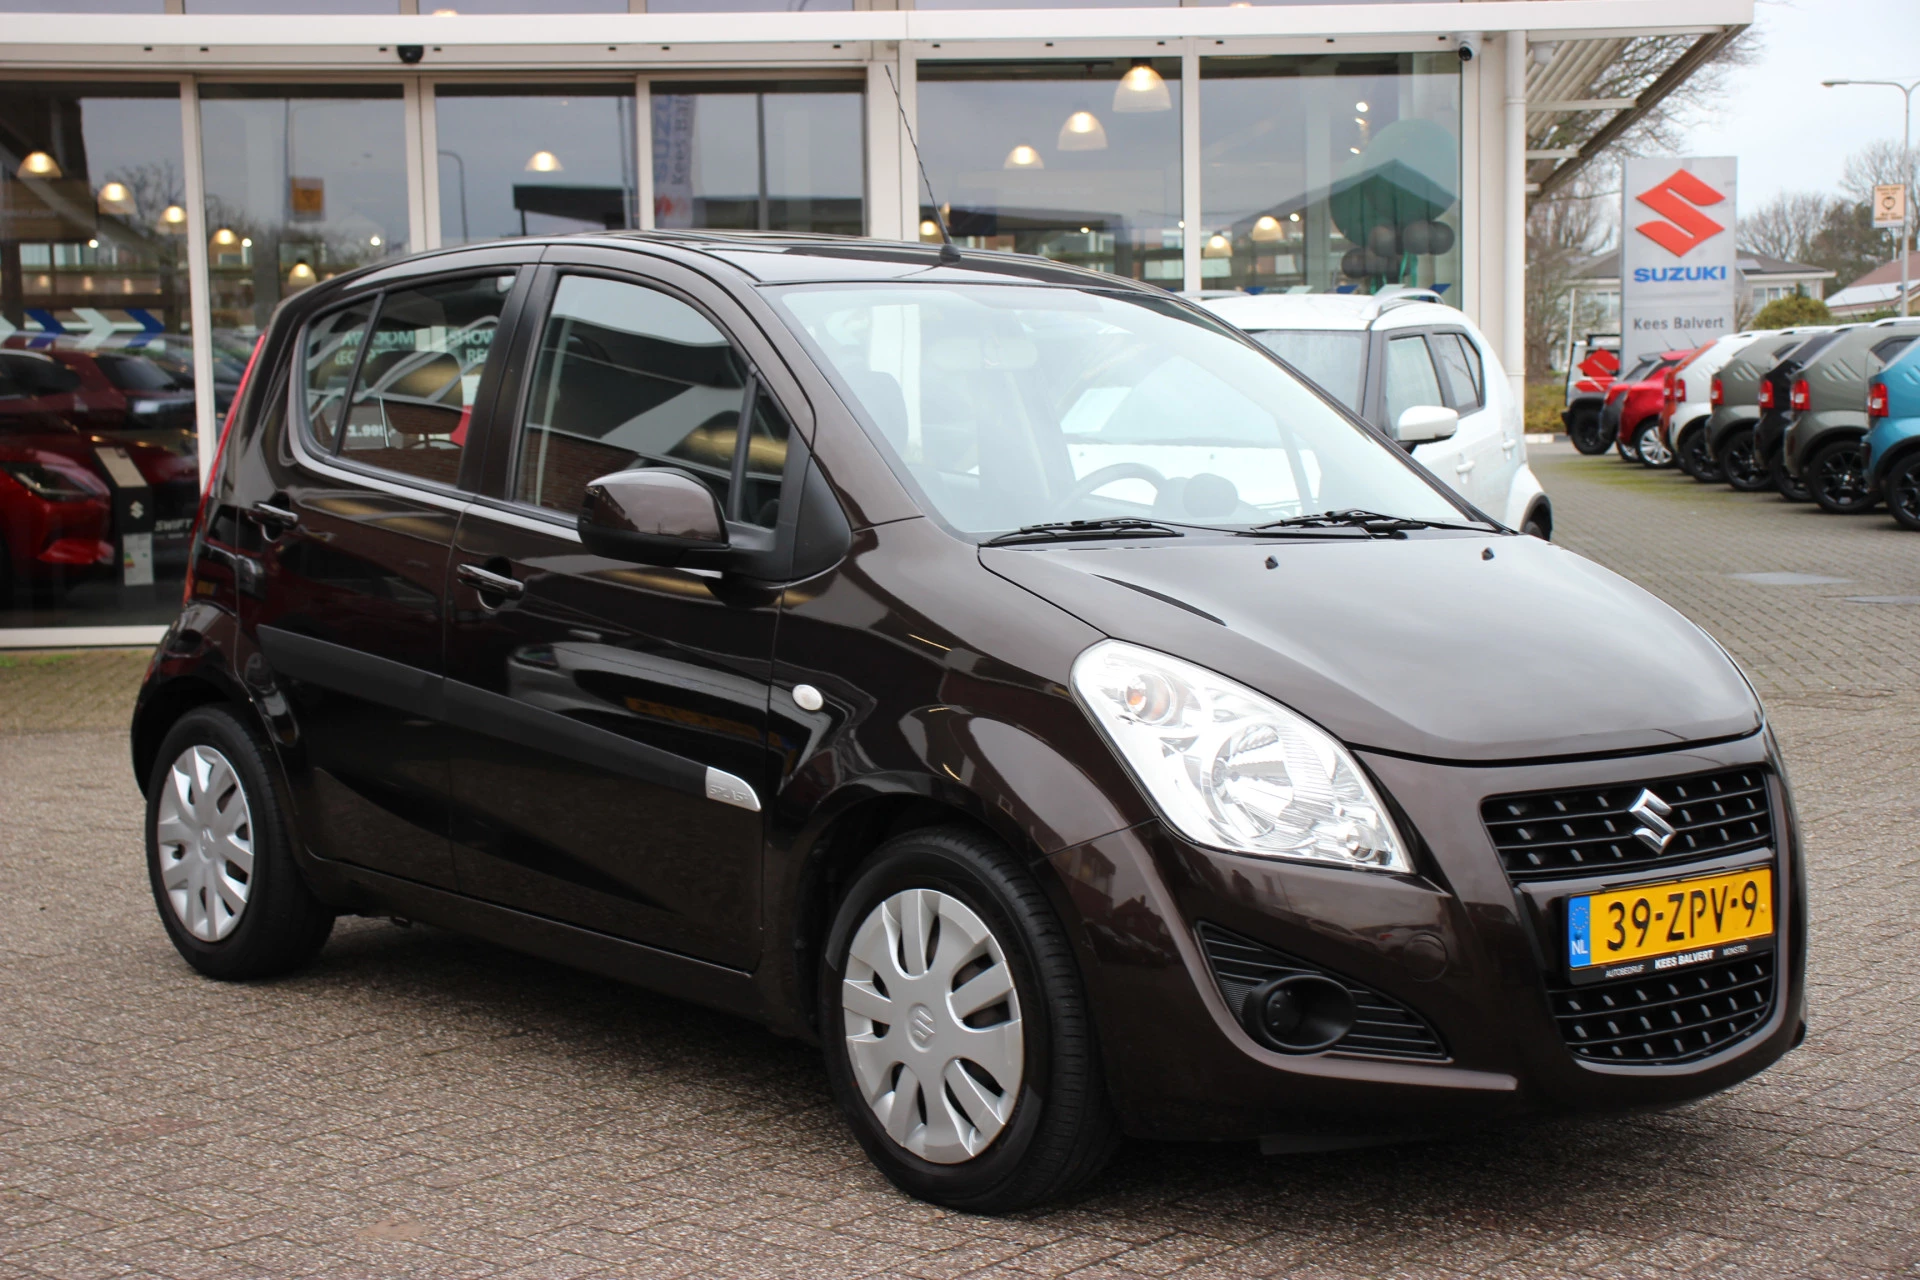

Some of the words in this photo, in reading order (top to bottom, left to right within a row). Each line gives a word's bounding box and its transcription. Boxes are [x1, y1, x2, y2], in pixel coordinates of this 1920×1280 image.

[1634, 266, 1727, 282] SUZUKI
[1633, 318, 1668, 331] Kees
[1674, 316, 1724, 329] Balvert
[1607, 880, 1758, 951] 39-ZPV-9
[1571, 939, 1588, 955] NL
[1654, 956, 1677, 970] KEES
[1678, 950, 1714, 965] BALVERT
